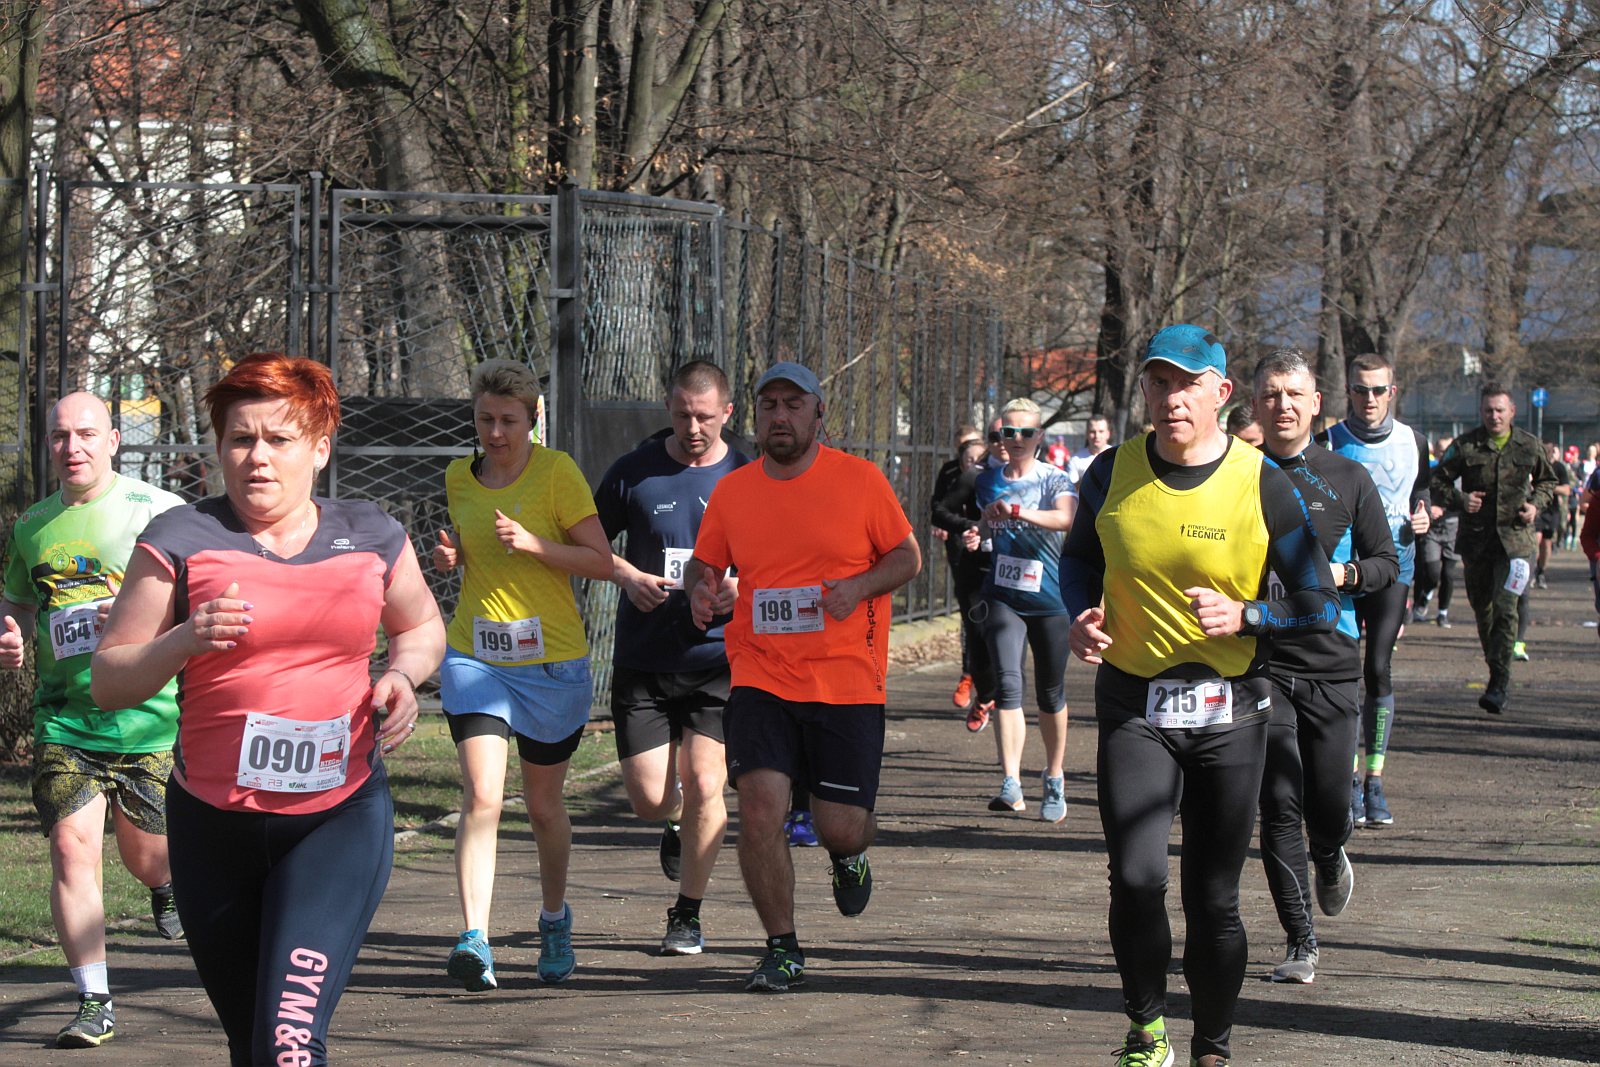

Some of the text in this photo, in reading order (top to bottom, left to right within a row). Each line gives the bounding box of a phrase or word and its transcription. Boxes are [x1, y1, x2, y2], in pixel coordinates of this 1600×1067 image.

[1186, 529, 1226, 542] LEGNICA
[998, 563, 1021, 582] 023
[758, 599, 793, 622] 198
[54, 617, 91, 647] 054
[478, 630, 513, 652] 199
[1153, 686, 1197, 714] 215
[248, 735, 316, 774] 090
